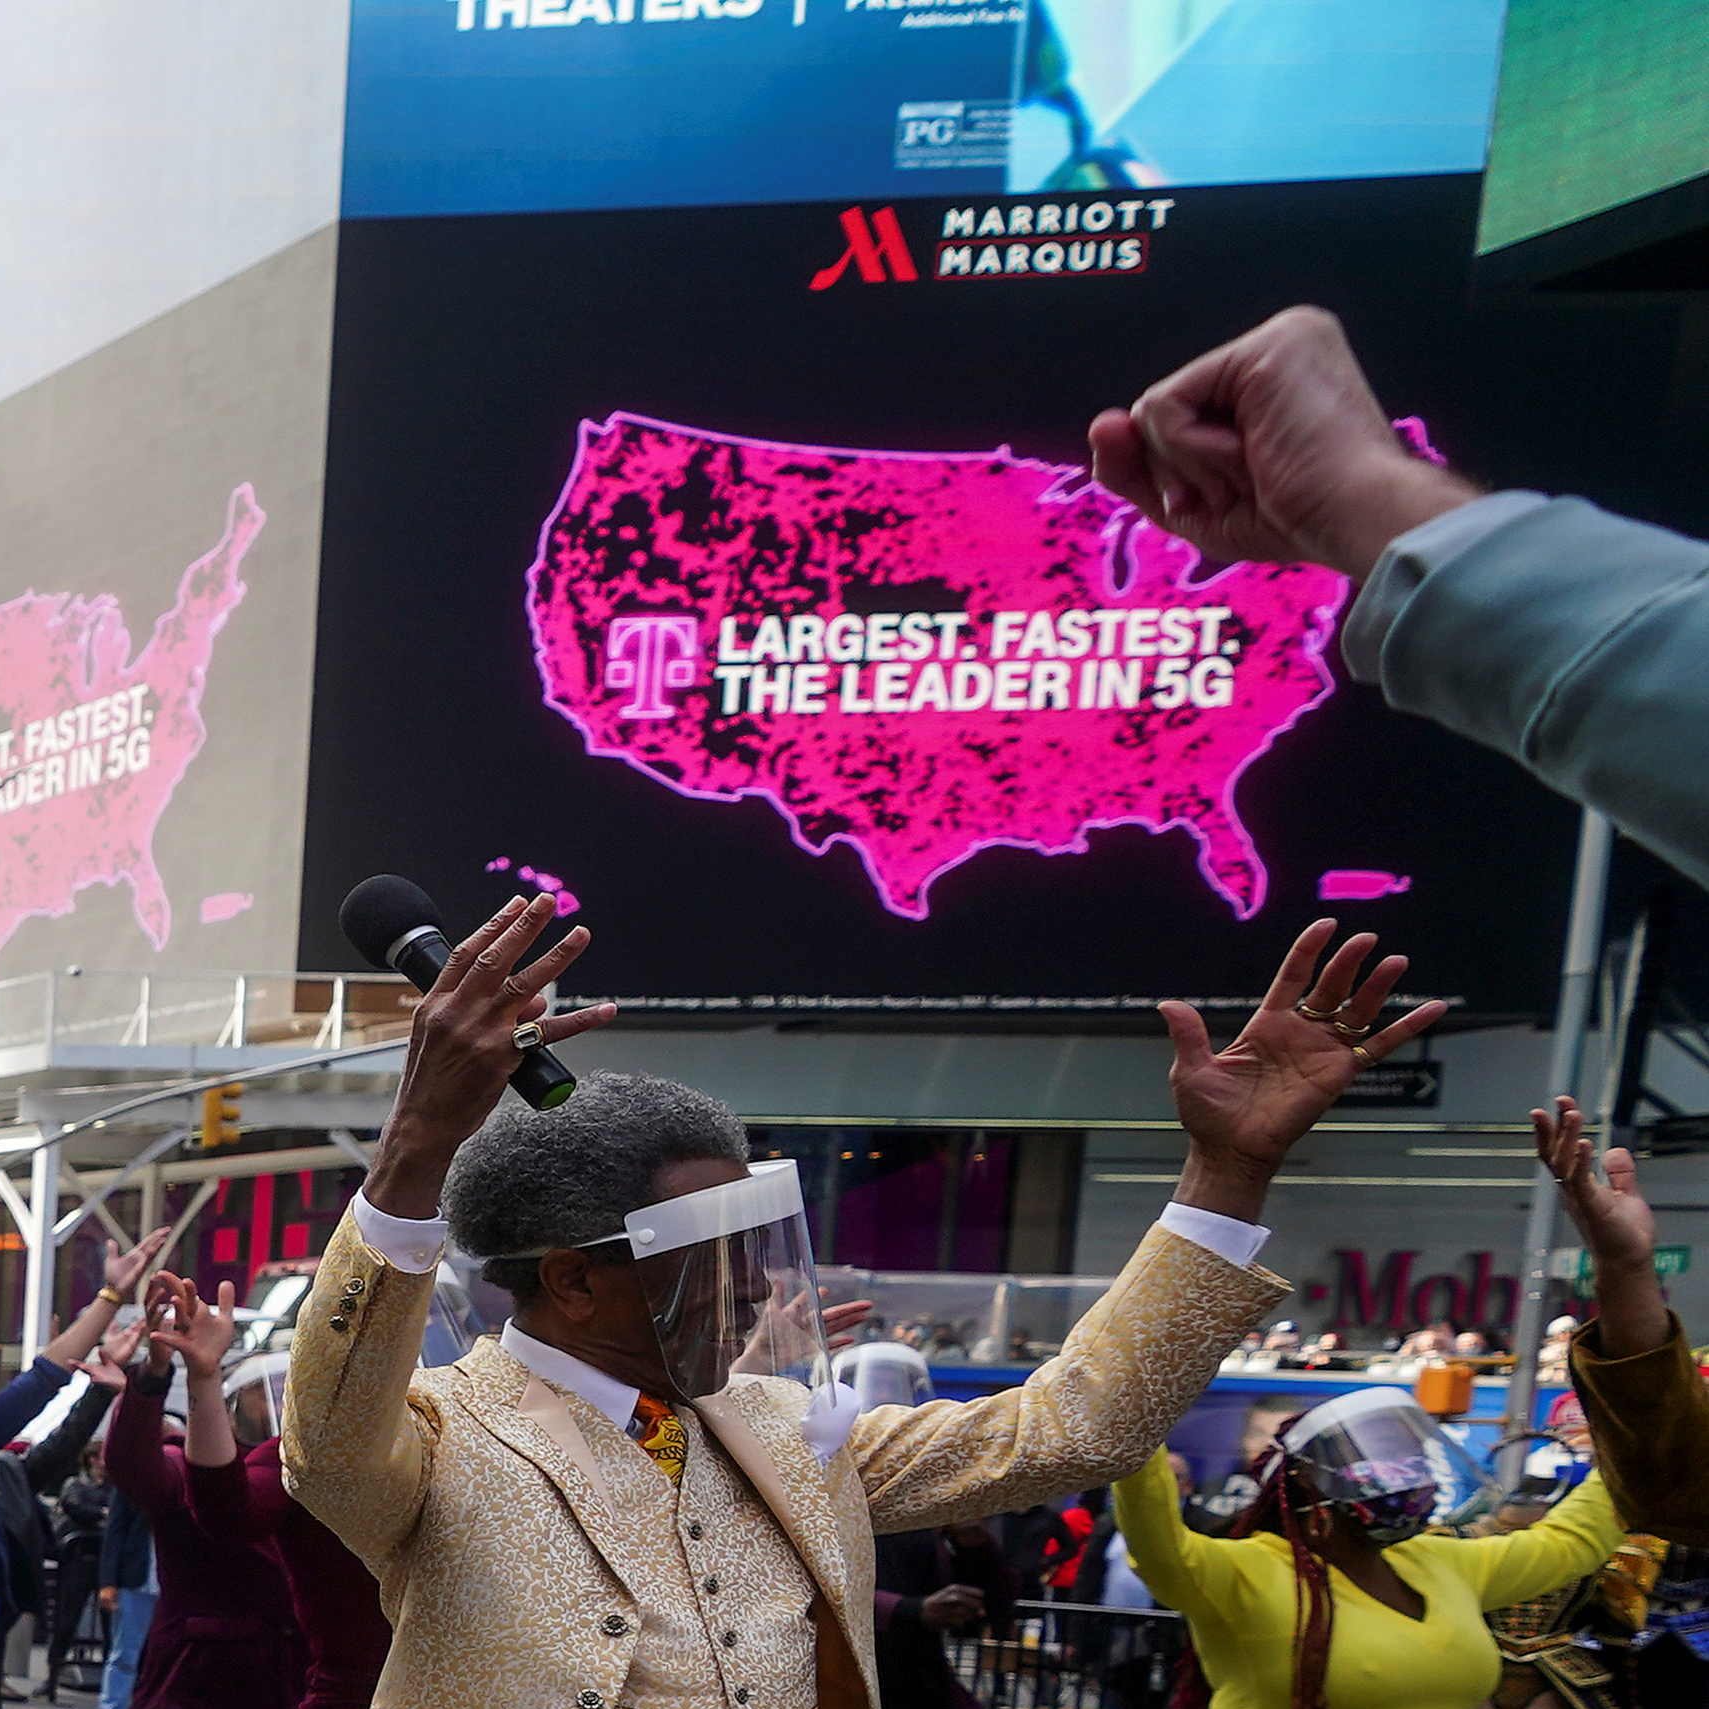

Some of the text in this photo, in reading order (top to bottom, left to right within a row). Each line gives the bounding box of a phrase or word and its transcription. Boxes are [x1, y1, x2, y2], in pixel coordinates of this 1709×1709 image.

[902, 118, 957, 146] PG
[943, 201, 1174, 239] MARRIOTT
[939, 239, 1143, 276] MARQUIS
[715, 614, 978, 665] LARGEST.
[989, 607, 1241, 659] FASTEST.
[715, 656, 1235, 715] THE LEADER IN 5G
[23, 684, 155, 759] FASTEST.
[69, 750, 102, 792] IN
[108, 728, 151, 782] 5G
